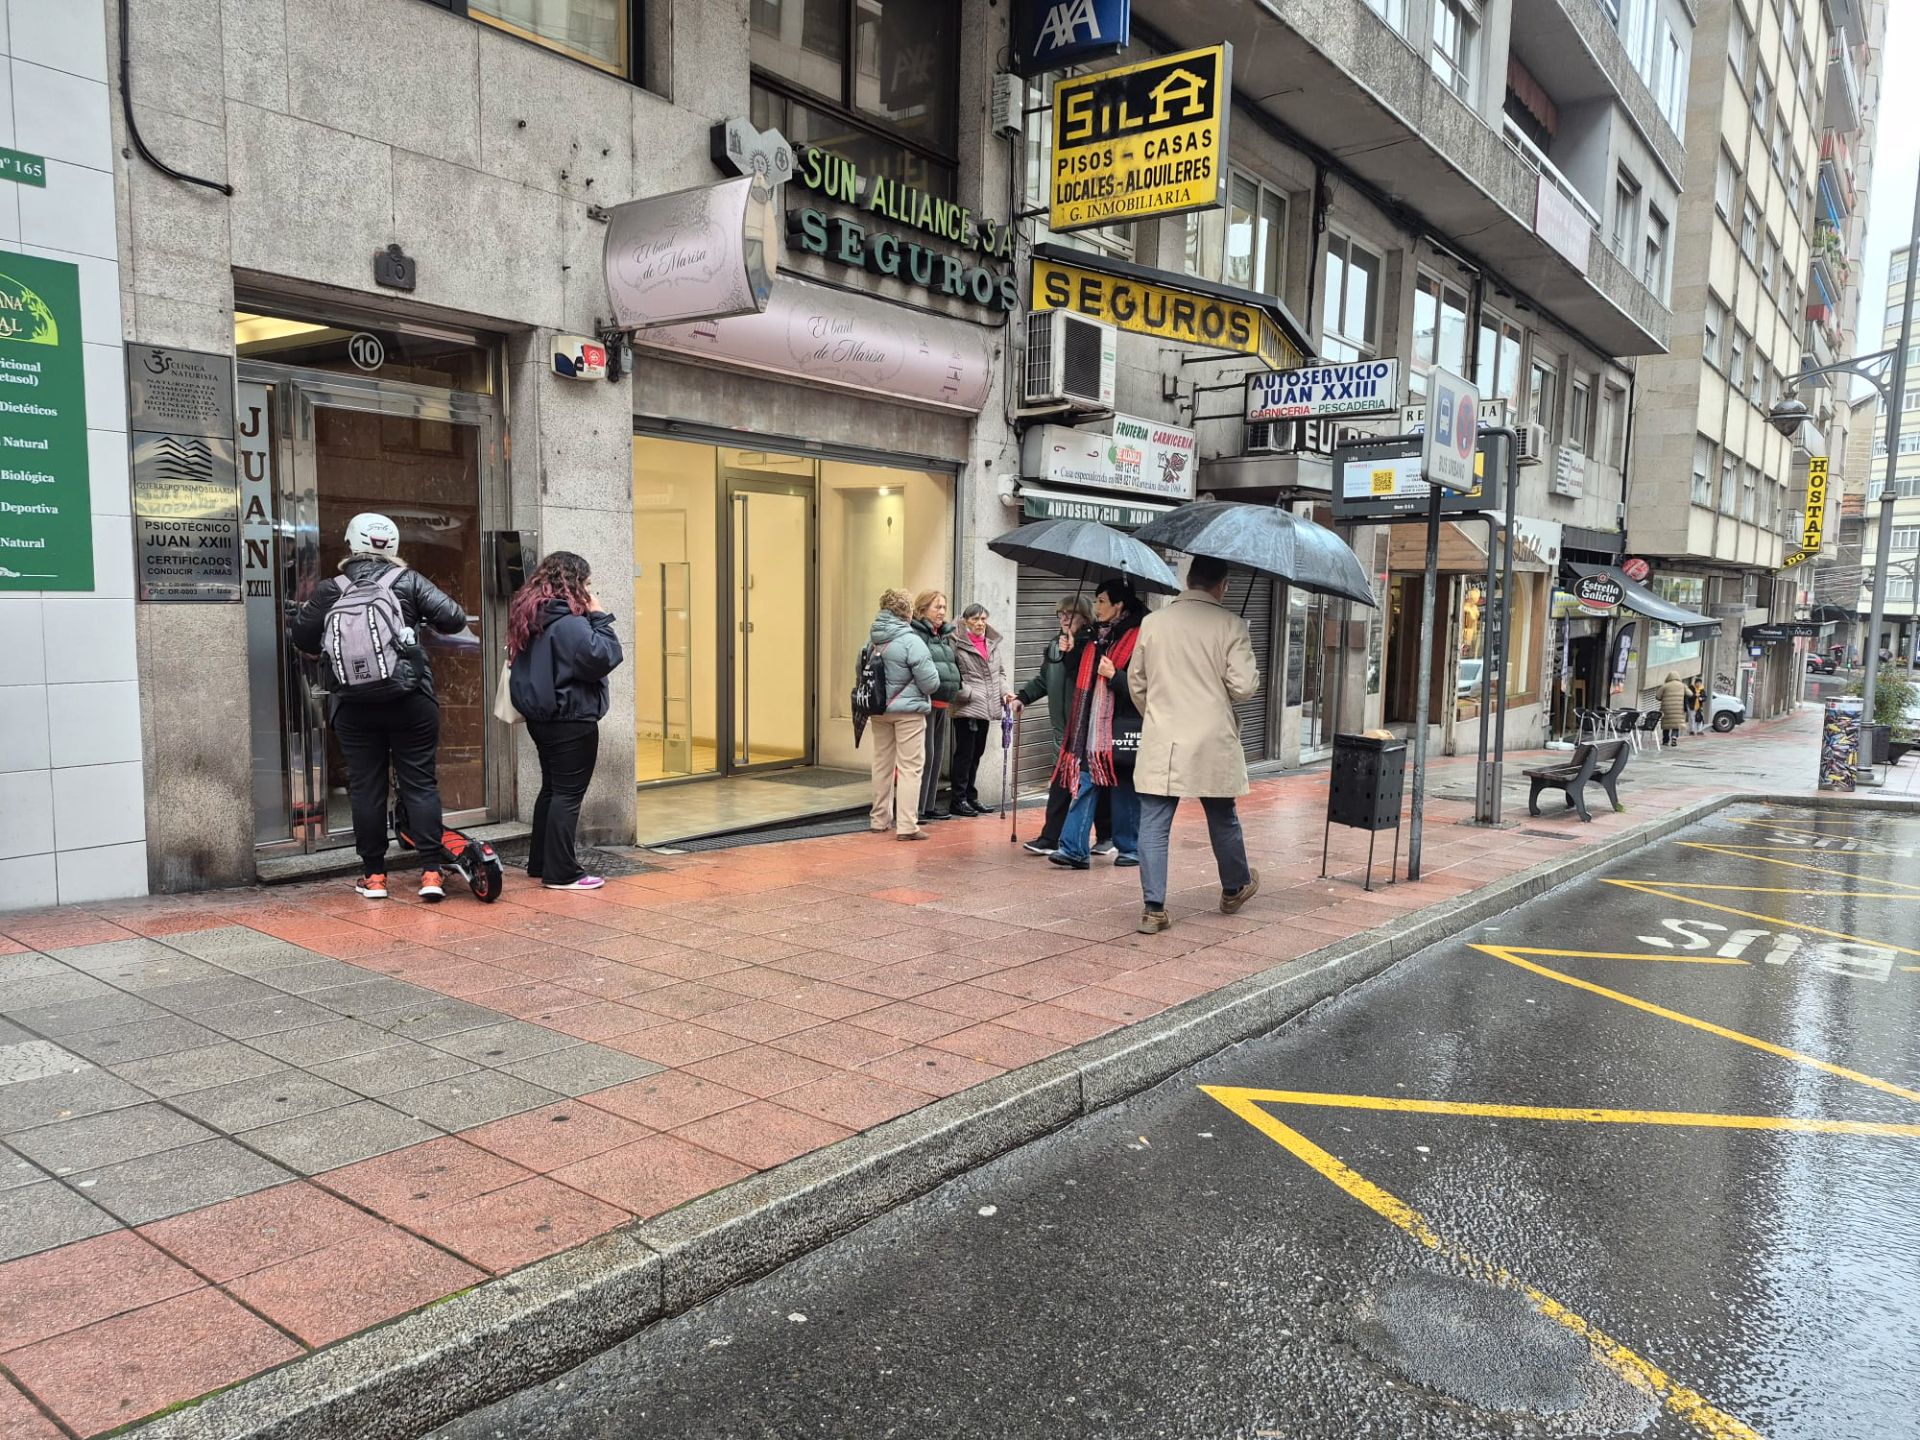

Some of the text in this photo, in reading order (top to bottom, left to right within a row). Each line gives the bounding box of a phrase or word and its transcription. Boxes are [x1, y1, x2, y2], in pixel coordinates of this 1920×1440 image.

[1033, 0, 1101, 57] AXA
[1066, 68, 1208, 141] SILA
[1057, 149, 1113, 177] PISOS
[1144, 128, 1213, 160] CASAS
[15, 159, 42, 177] 165
[803, 148, 857, 204] SUN
[1069, 188, 1192, 222] G. INMOBILIARIA
[643, 249, 707, 281] de Marisa
[801, 207, 1020, 312] SEGUROS
[1045, 271, 1251, 346] SEGUROS
[354, 339, 380, 365] 10
[813, 339, 886, 364] de Marisa
[1251, 363, 1389, 391] AUTOSERVICIO
[1261, 380, 1376, 410] JUAN XXIII
[0, 401, 58, 417] Dietéticos
[1250, 405, 1311, 419] CARNICERIA
[1318, 399, 1386, 414] PESCADERIA
[1115, 421, 1149, 441] FRUTERIA
[1152, 430, 1194, 450] CARNICERIA
[3, 436, 48, 450] Natural
[1, 469, 56, 485] Biológica
[0, 501, 58, 515] Deportiva
[1047, 501, 1120, 522] AUTOSERVICIO
[1804, 460, 1827, 548] HOSTAL
[0, 537, 45, 548] Natural
[146, 534, 232, 549] JUAN XXIII
[147, 555, 232, 566] CERTIFICADOS
[147, 567, 193, 576] CONDUCIR
[202, 568, 232, 576] ARMAS
[1581, 588, 1616, 604] Galicia
[1582, 579, 1619, 595] Estrella
